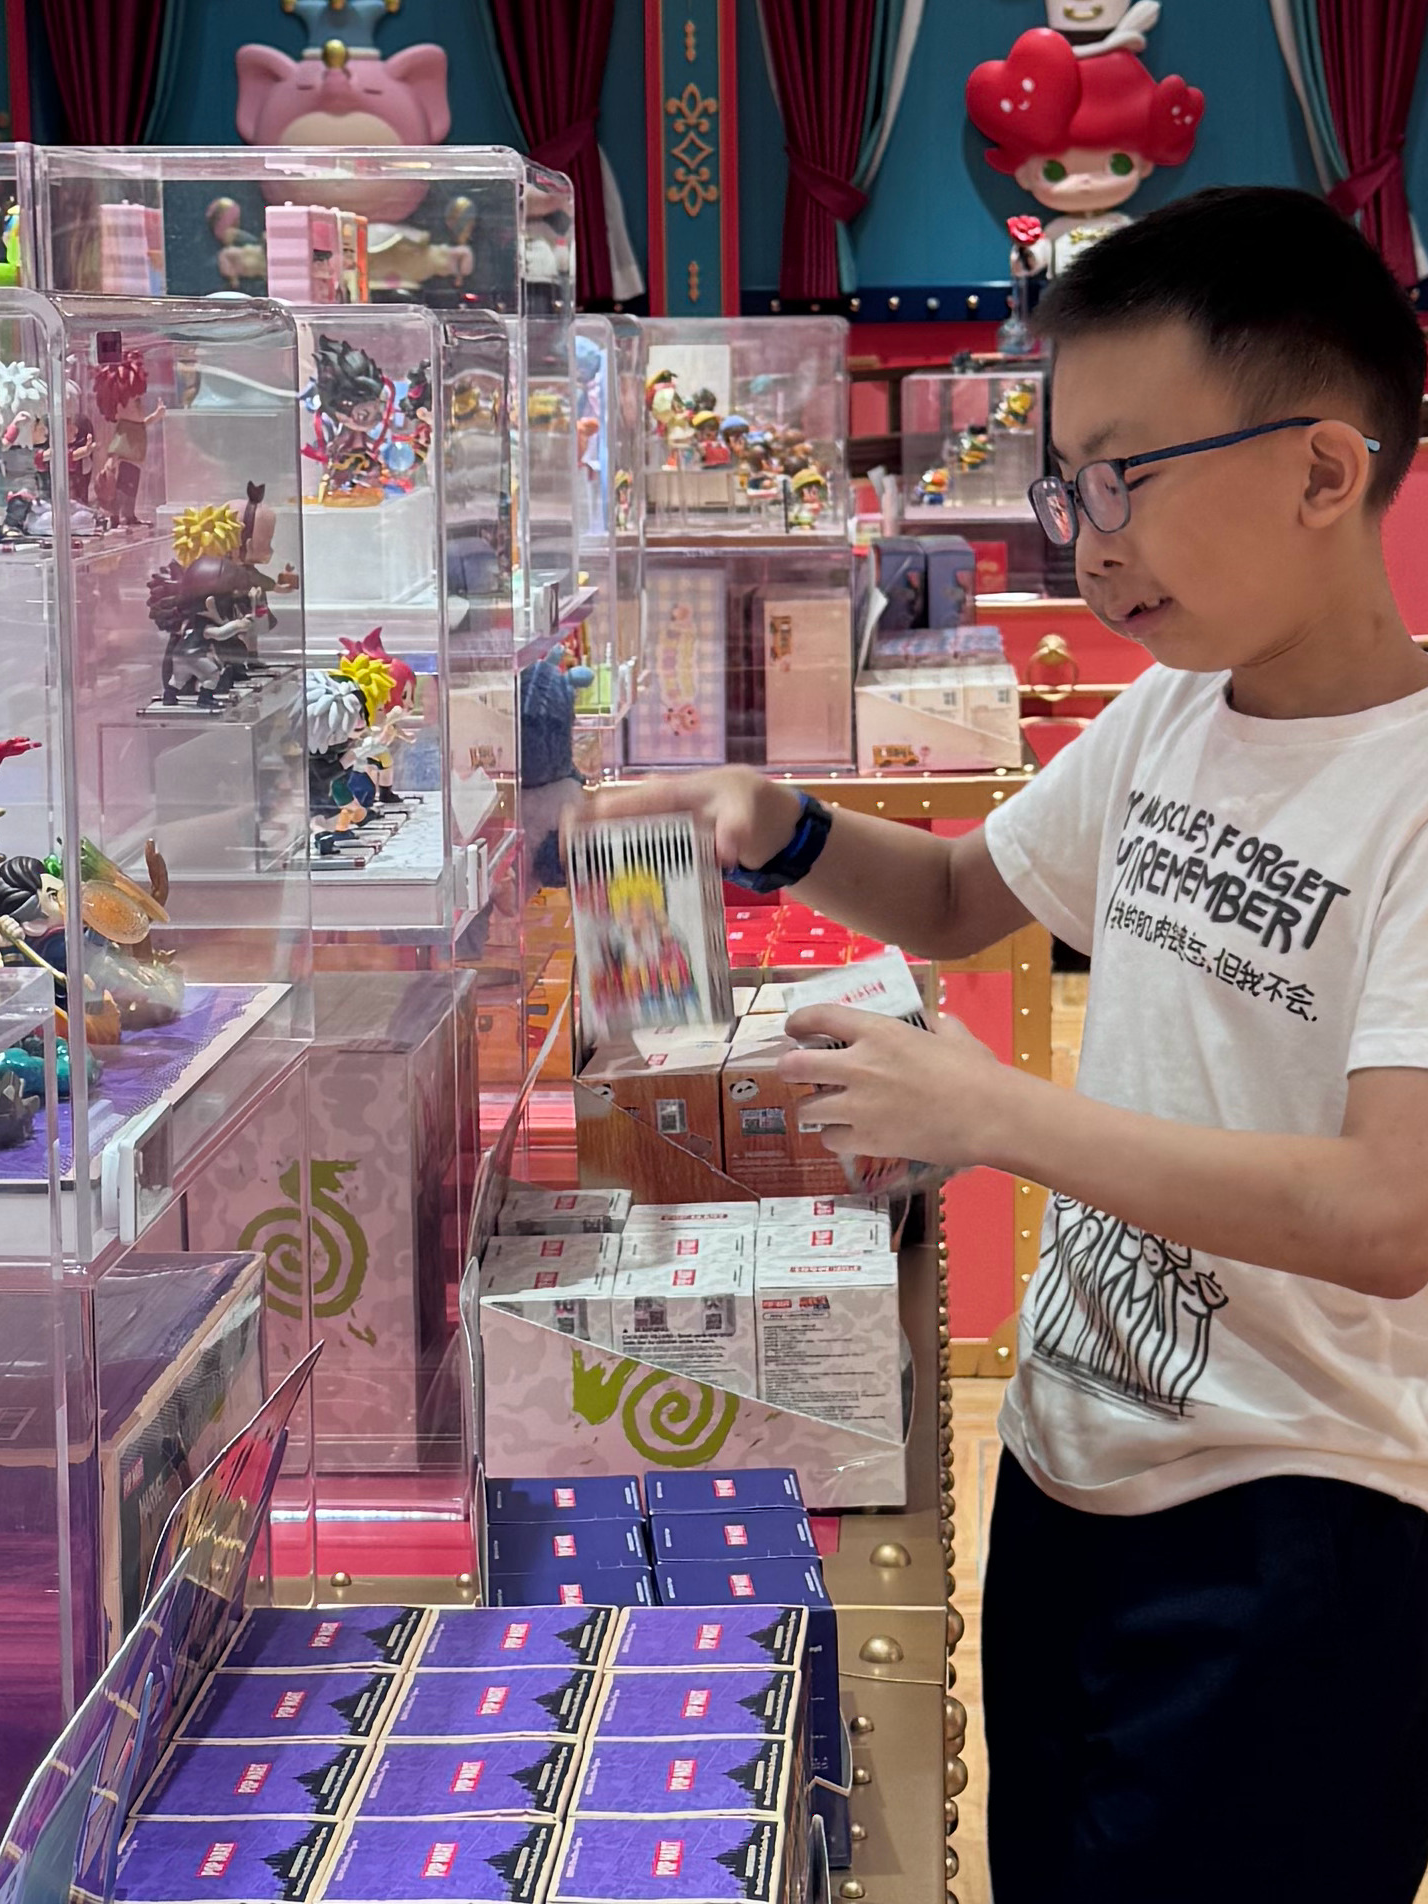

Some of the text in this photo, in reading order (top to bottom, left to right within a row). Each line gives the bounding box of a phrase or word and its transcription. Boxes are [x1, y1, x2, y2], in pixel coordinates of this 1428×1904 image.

[1123, 790, 1351, 950] Y MUSCLES FORGET
